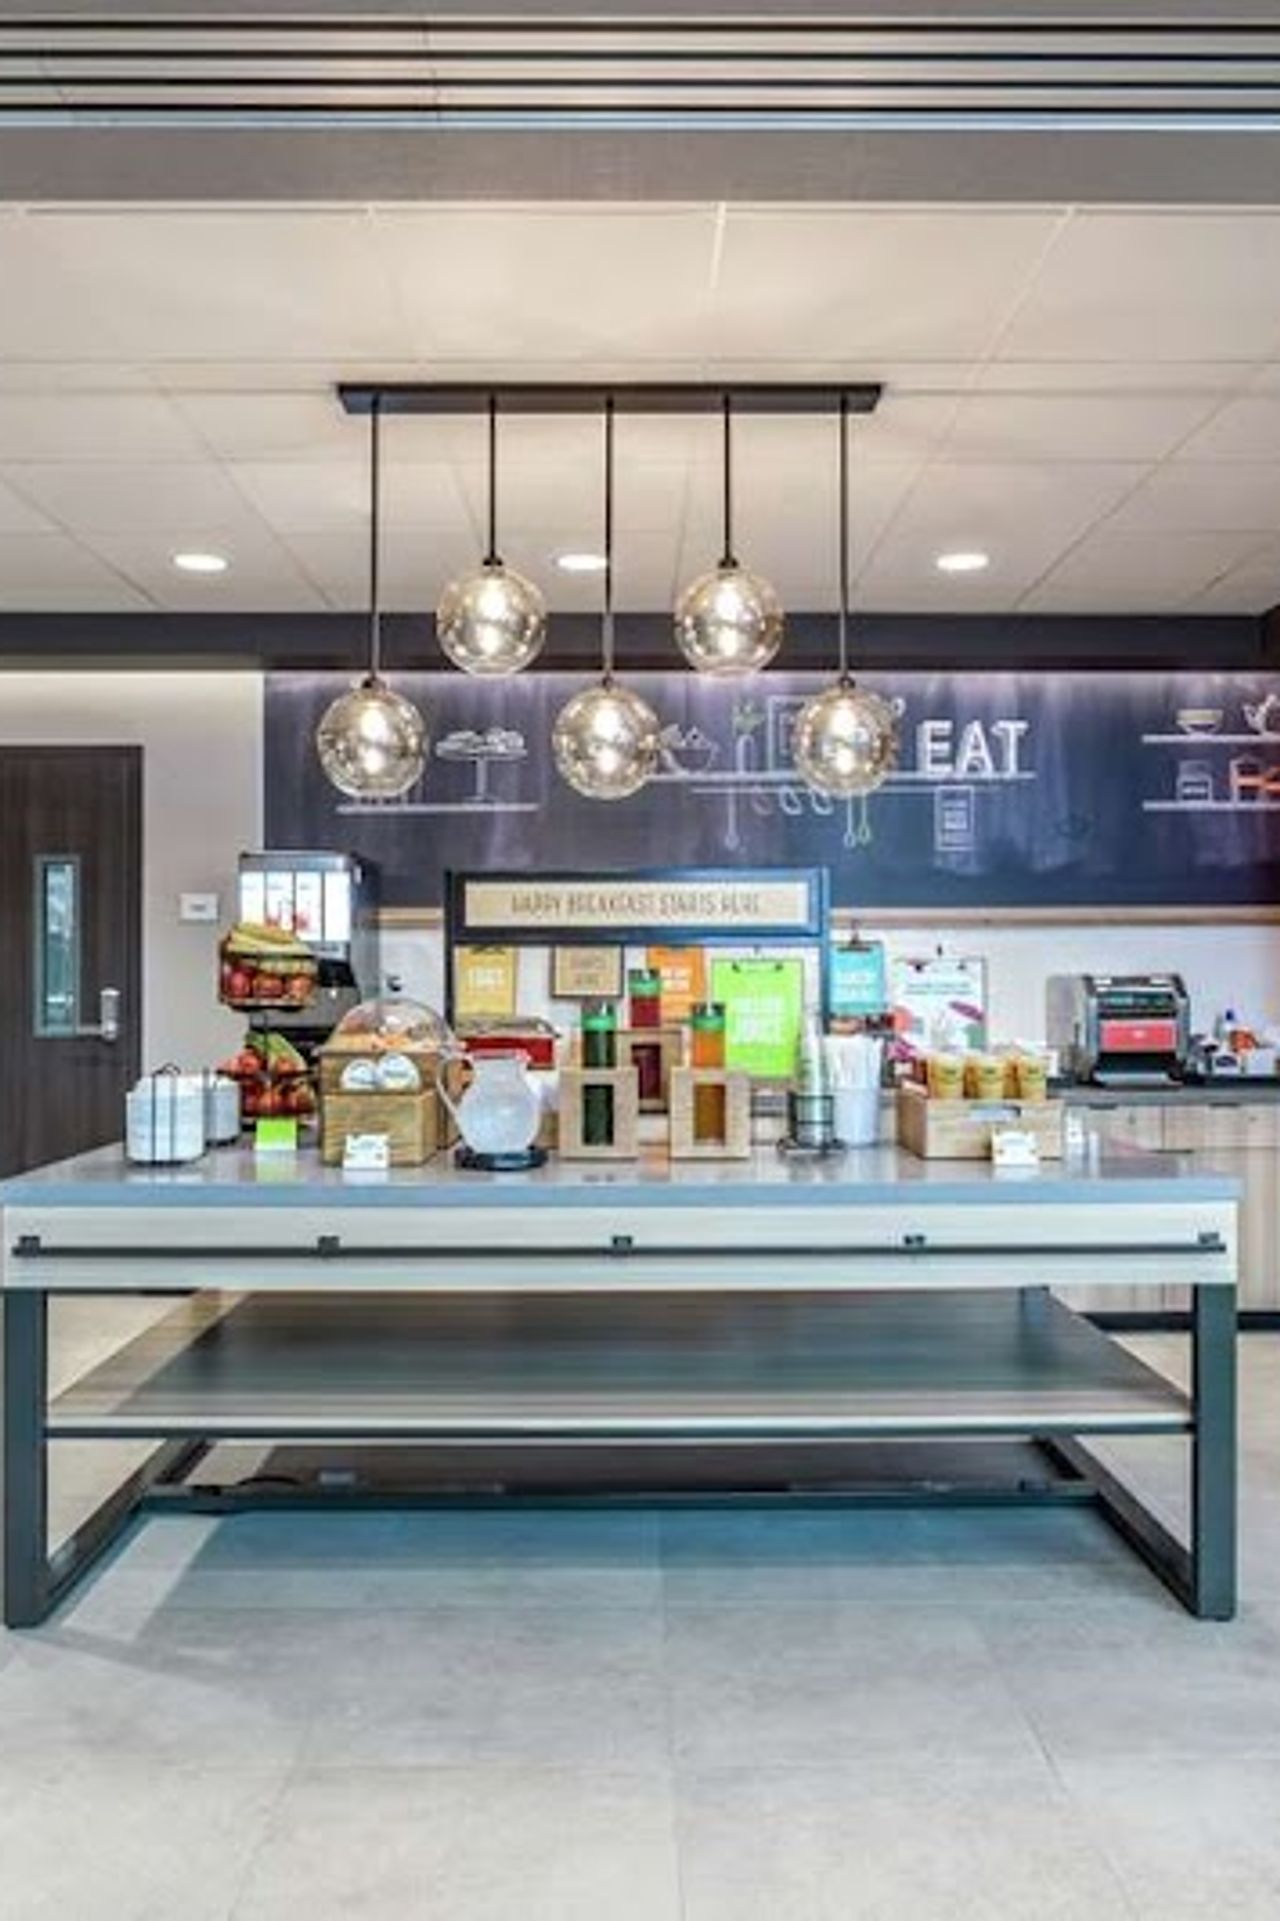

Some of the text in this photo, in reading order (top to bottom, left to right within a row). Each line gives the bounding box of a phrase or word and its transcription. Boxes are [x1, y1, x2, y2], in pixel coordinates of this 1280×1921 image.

[917, 719, 1028, 779] EAT
[511, 891, 561, 916] HAPPY
[567, 891, 652, 916] BREAKFAST
